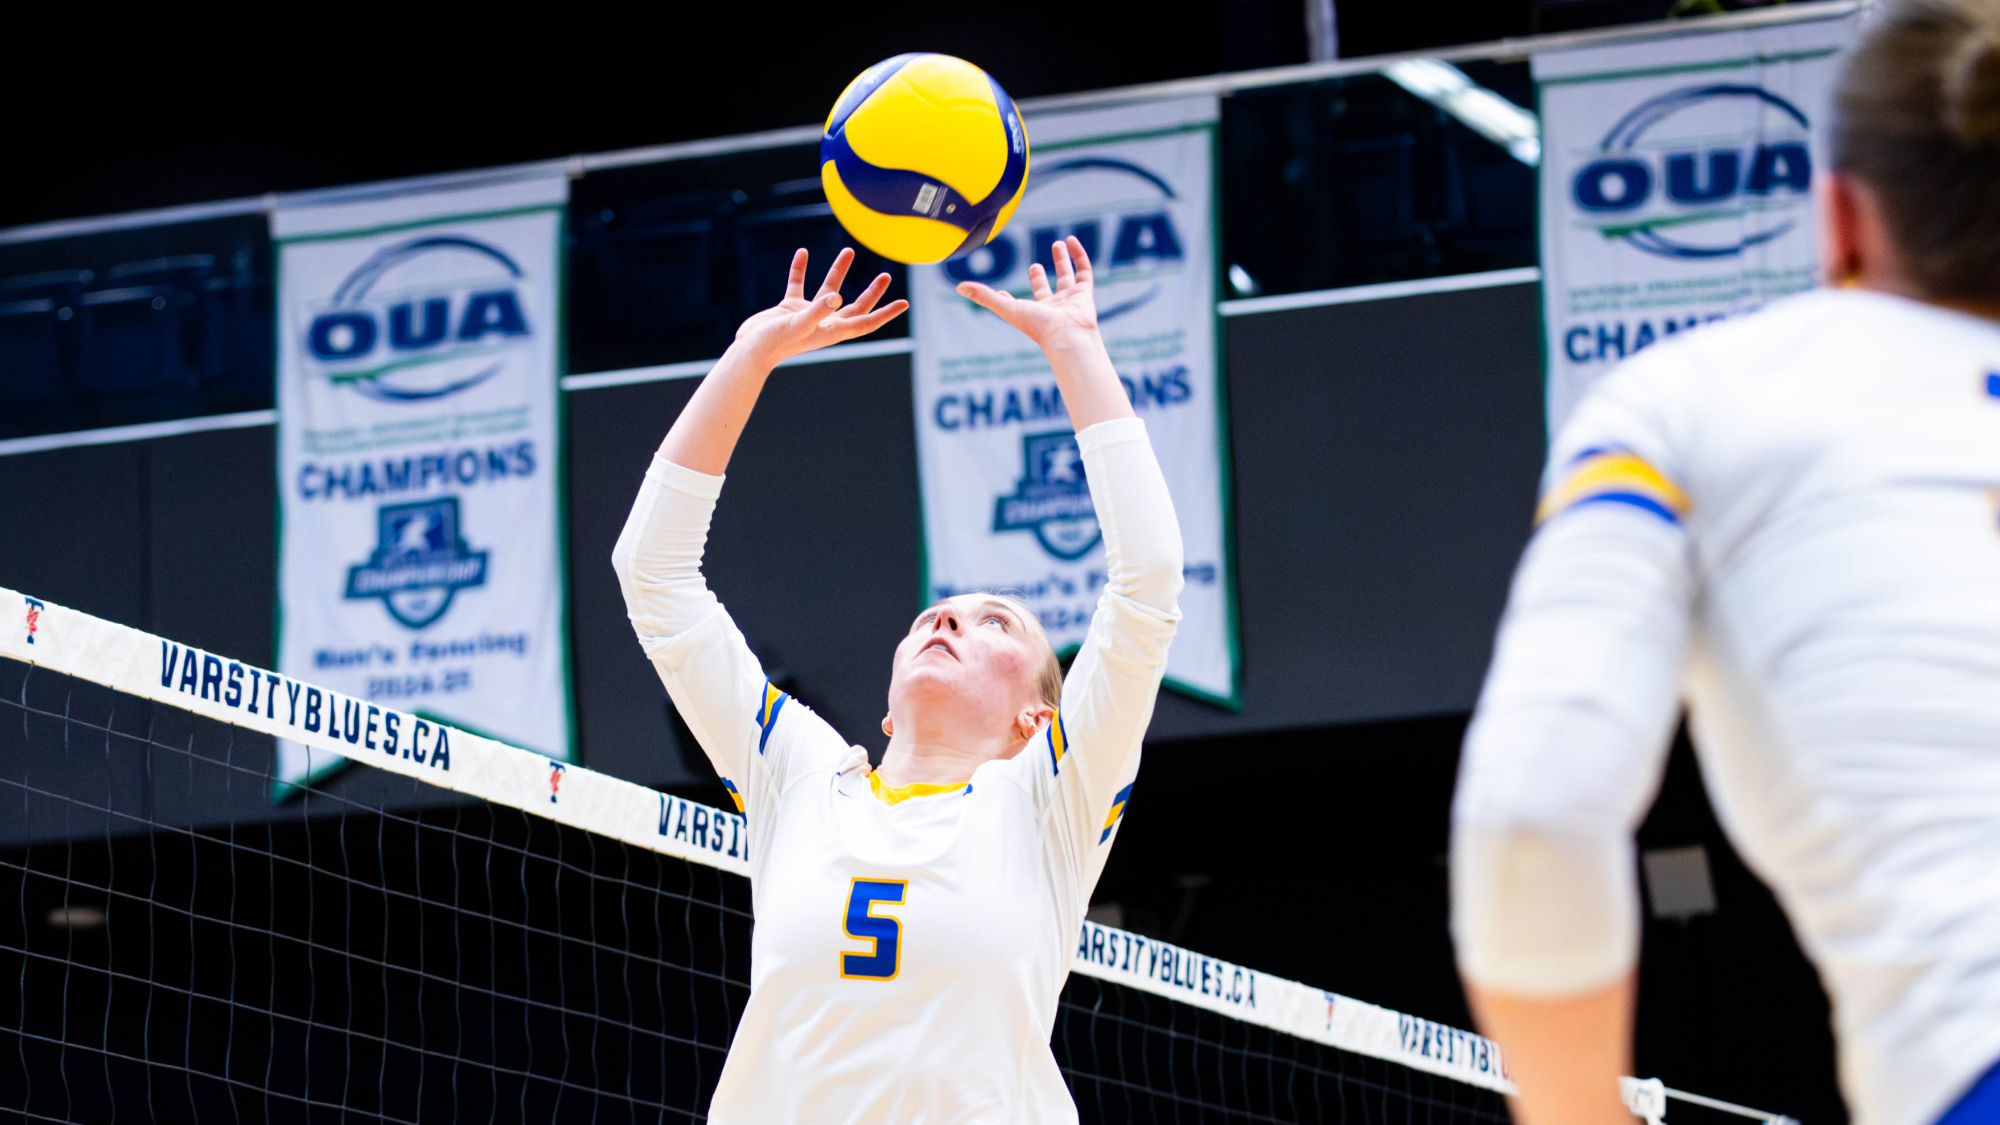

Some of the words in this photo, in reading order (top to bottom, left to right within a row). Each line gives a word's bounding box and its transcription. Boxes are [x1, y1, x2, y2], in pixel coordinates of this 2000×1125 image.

[1573, 141, 1812, 212] OUA
[308, 288, 530, 362] OUA
[299, 440, 535, 499] CHAMPIONS
[160, 640, 450, 771] VARSITYBLUES.CA
[659, 793, 748, 861] VARSI
[839, 876, 908, 982] 5
[1077, 925, 1256, 1009] ARSITYBLUES.CA
